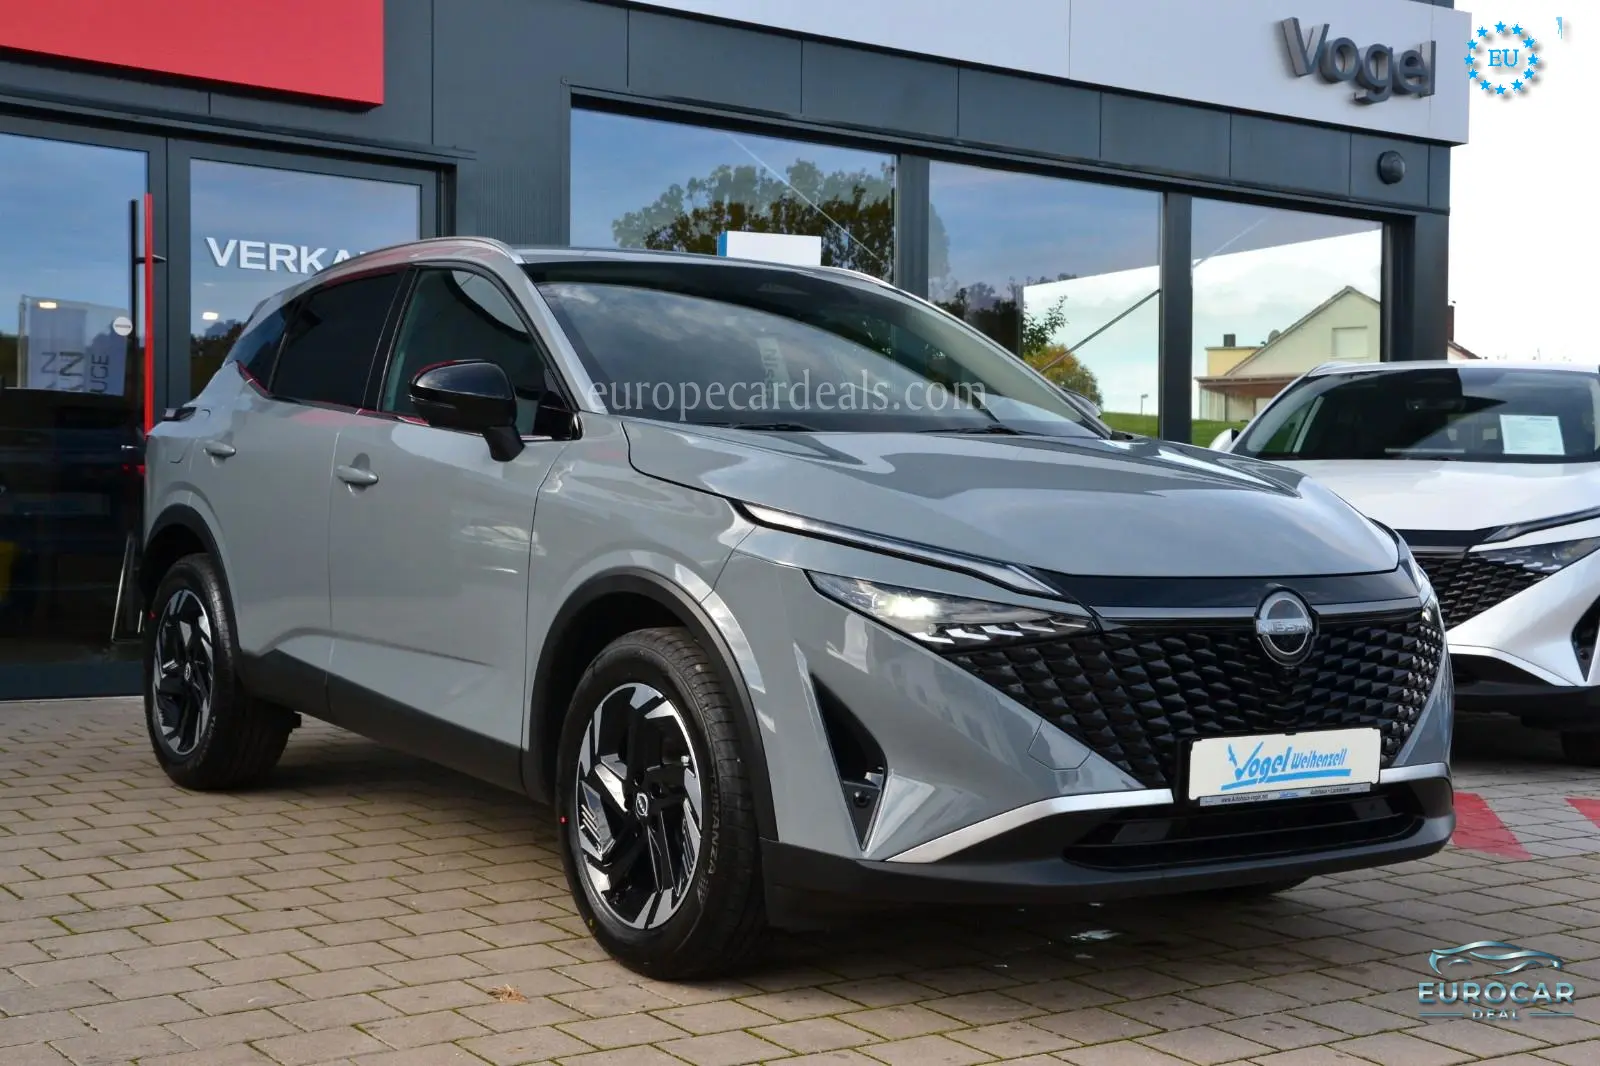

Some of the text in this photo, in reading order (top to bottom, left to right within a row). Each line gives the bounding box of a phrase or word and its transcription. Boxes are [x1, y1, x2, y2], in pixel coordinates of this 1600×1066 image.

[1280, 17, 1436, 104] Vogel
[205, 236, 366, 274] VERK
[1228, 741, 1348, 784] Vogel Weihenzell
